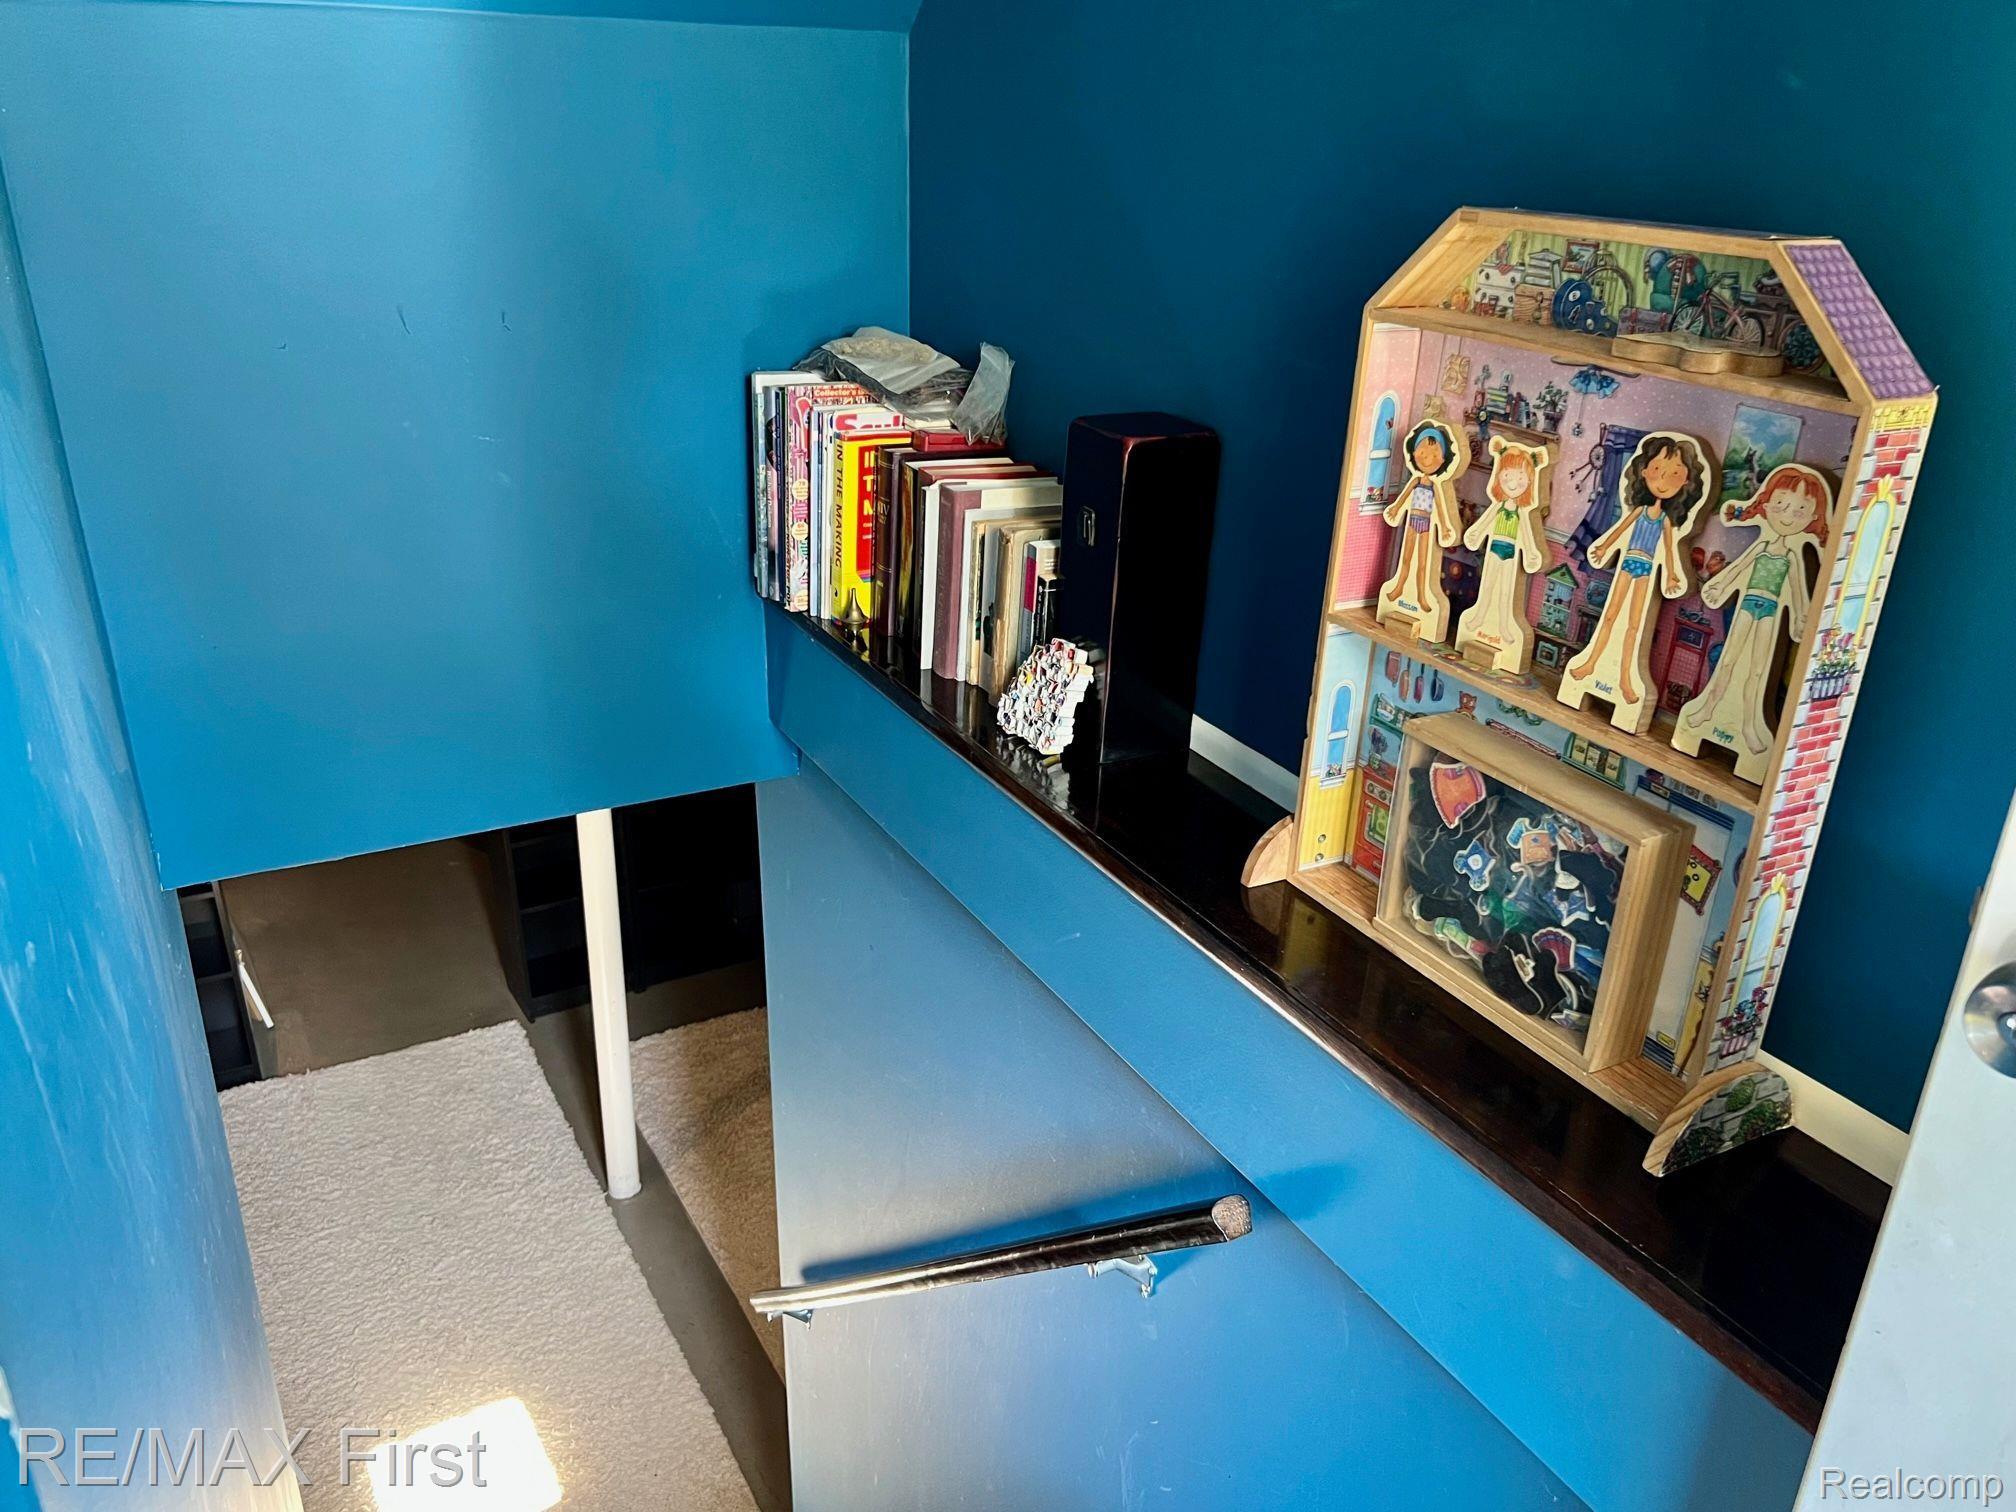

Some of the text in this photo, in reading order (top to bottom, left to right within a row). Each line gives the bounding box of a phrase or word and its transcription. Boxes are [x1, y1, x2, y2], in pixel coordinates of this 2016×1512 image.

[836, 444, 843, 462] IN
[835, 504, 843, 568] MAKING
[1594, 679, 1613, 695] Violet
[1711, 726, 1735, 744] Poppy
